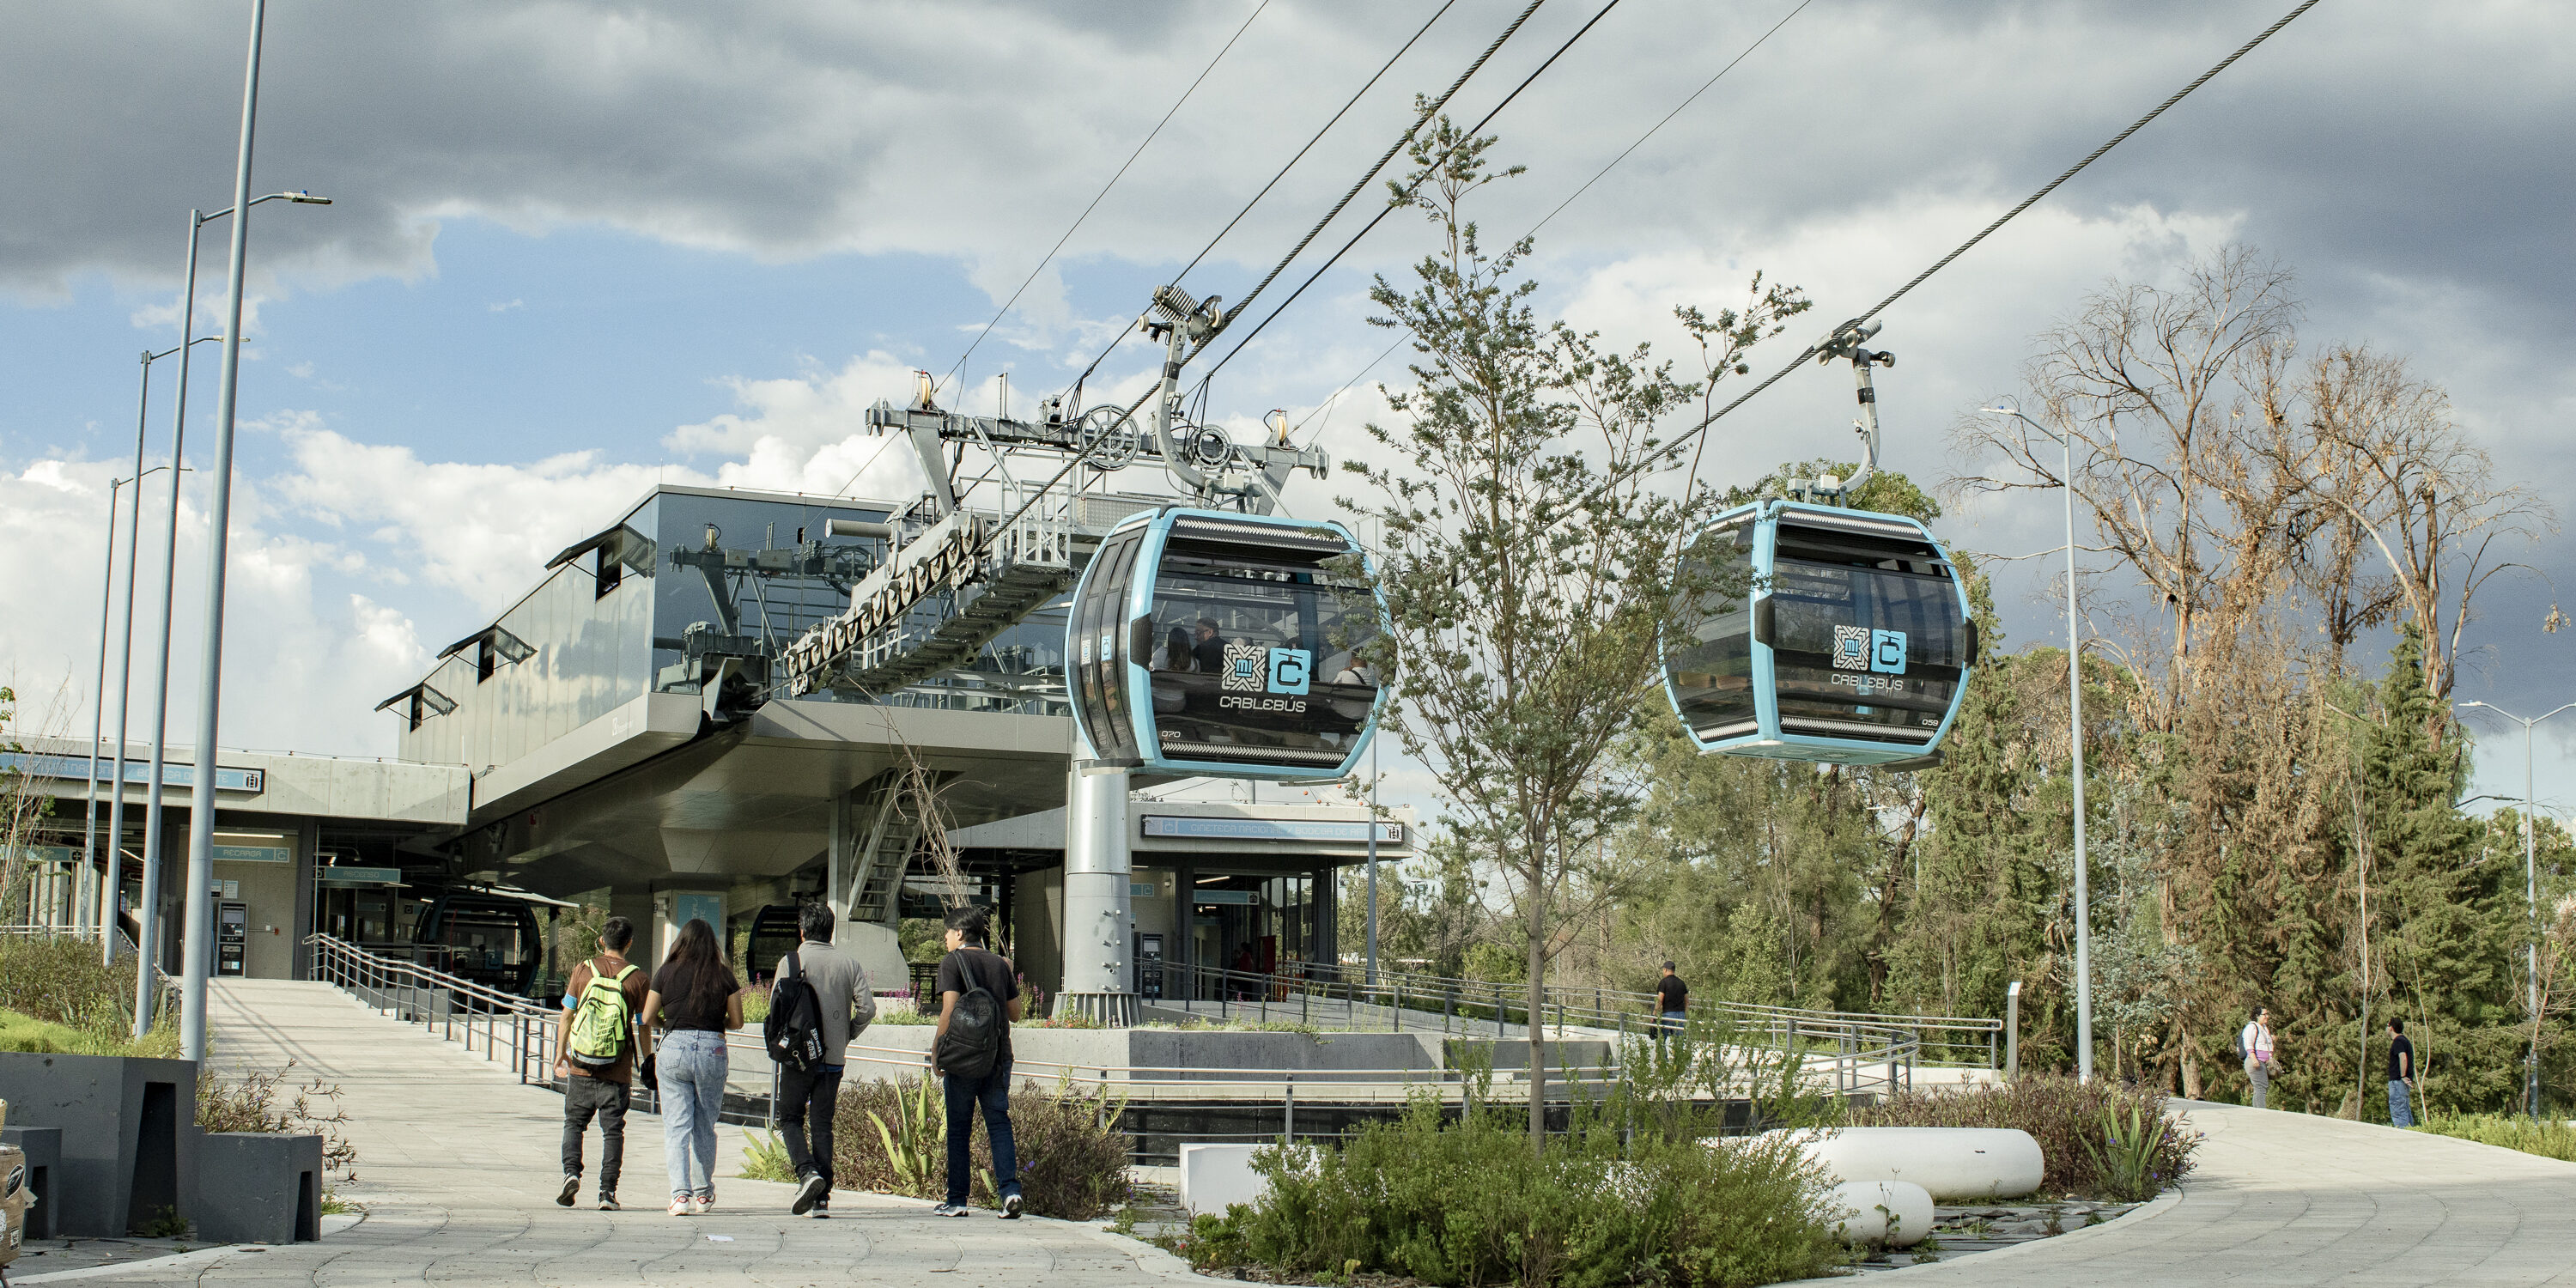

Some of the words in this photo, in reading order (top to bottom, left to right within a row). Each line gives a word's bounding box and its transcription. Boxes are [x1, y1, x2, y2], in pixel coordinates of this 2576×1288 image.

[1831, 674, 1904, 690] CABLEBÚS
[1219, 696, 1307, 713] CABLEBÚS
[1161, 730, 1182, 738] 070
[70, 763, 115, 775] NACON
[137, 769, 181, 781] BOGA
[1190, 823, 1236, 834] CINETECA
[1238, 824, 1283, 835] NACIONAL
[1295, 826, 1333, 835] BODEGA
[1334, 828, 1346, 836] DE
[223, 849, 262, 858] RECARGA
